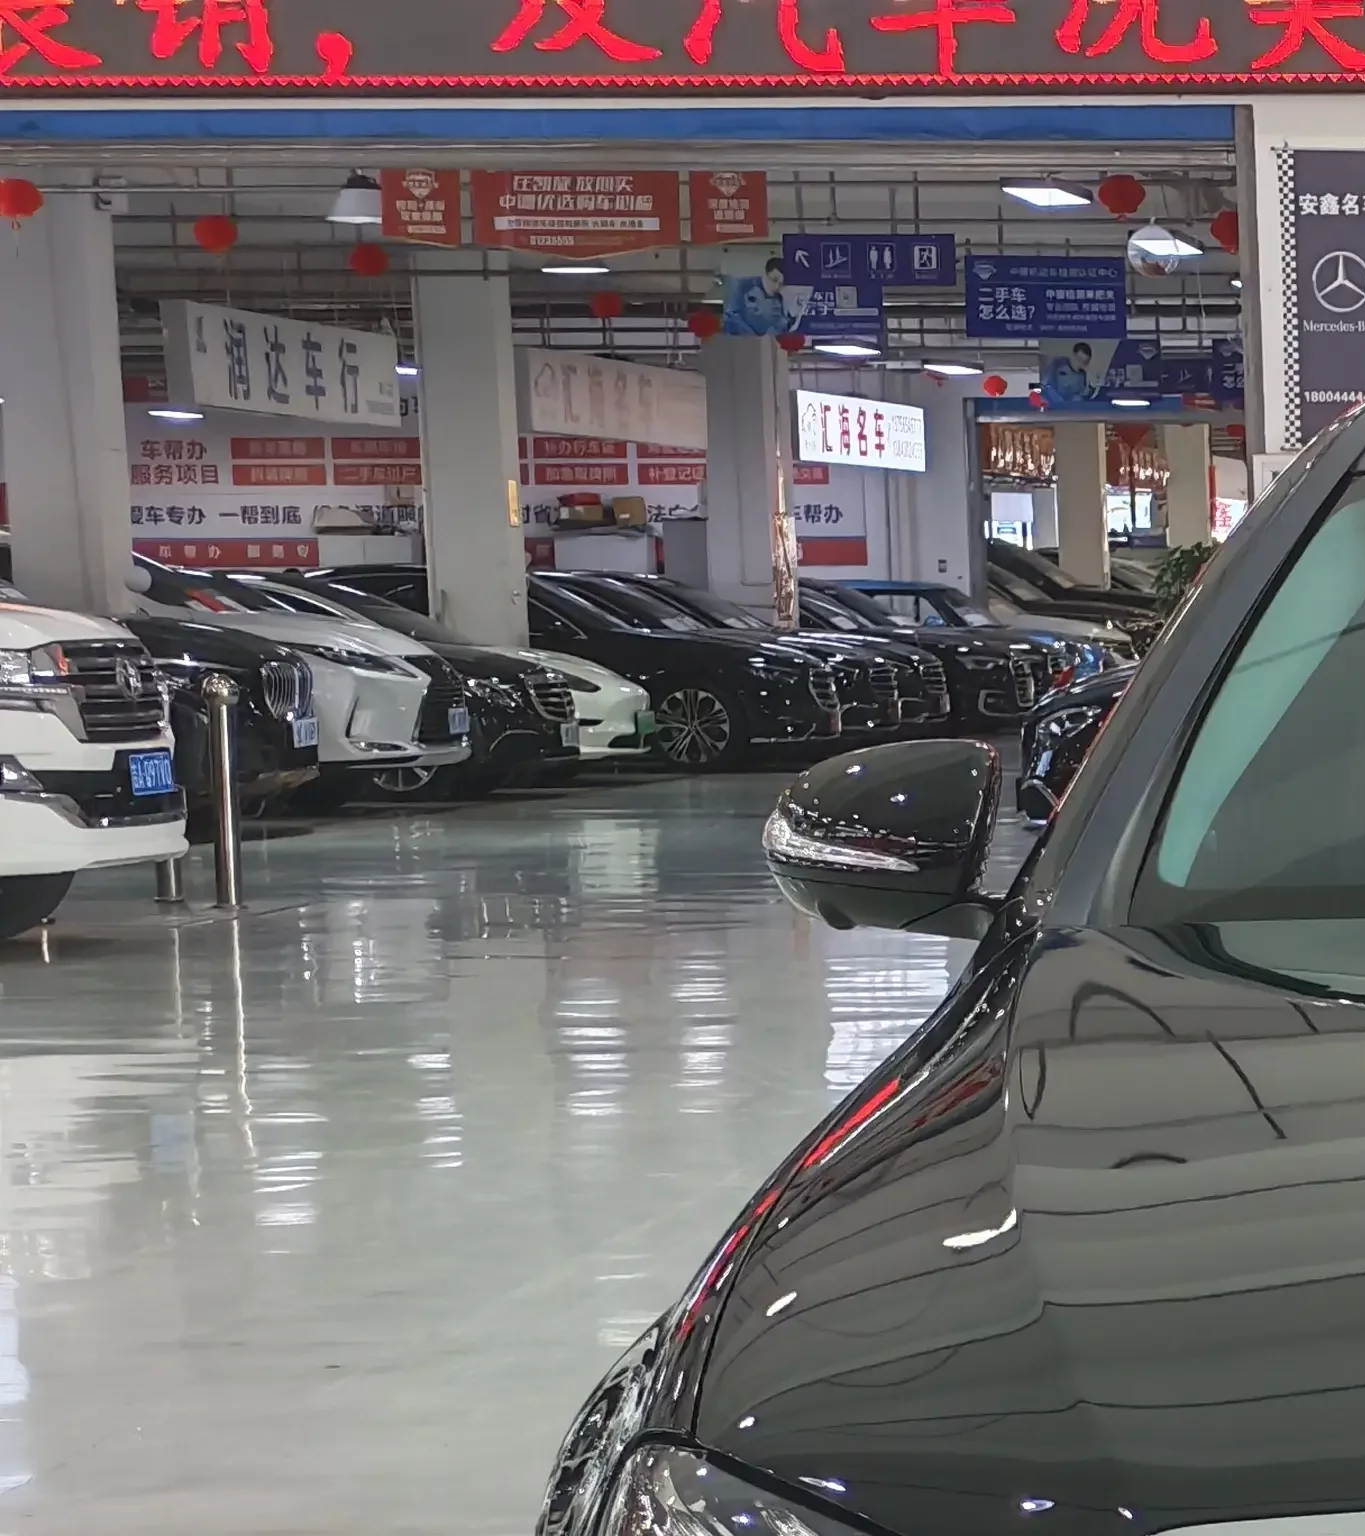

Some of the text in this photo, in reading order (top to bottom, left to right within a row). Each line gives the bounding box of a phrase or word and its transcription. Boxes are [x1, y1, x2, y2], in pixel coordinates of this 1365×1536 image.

[978, 287, 1027, 302] 二手车
[222, 318, 360, 414] 润达车行
[820, 402, 886, 458] 汇海名车
[140, 439, 208, 461] 车帮办
[131, 464, 219, 485] 服务项目
